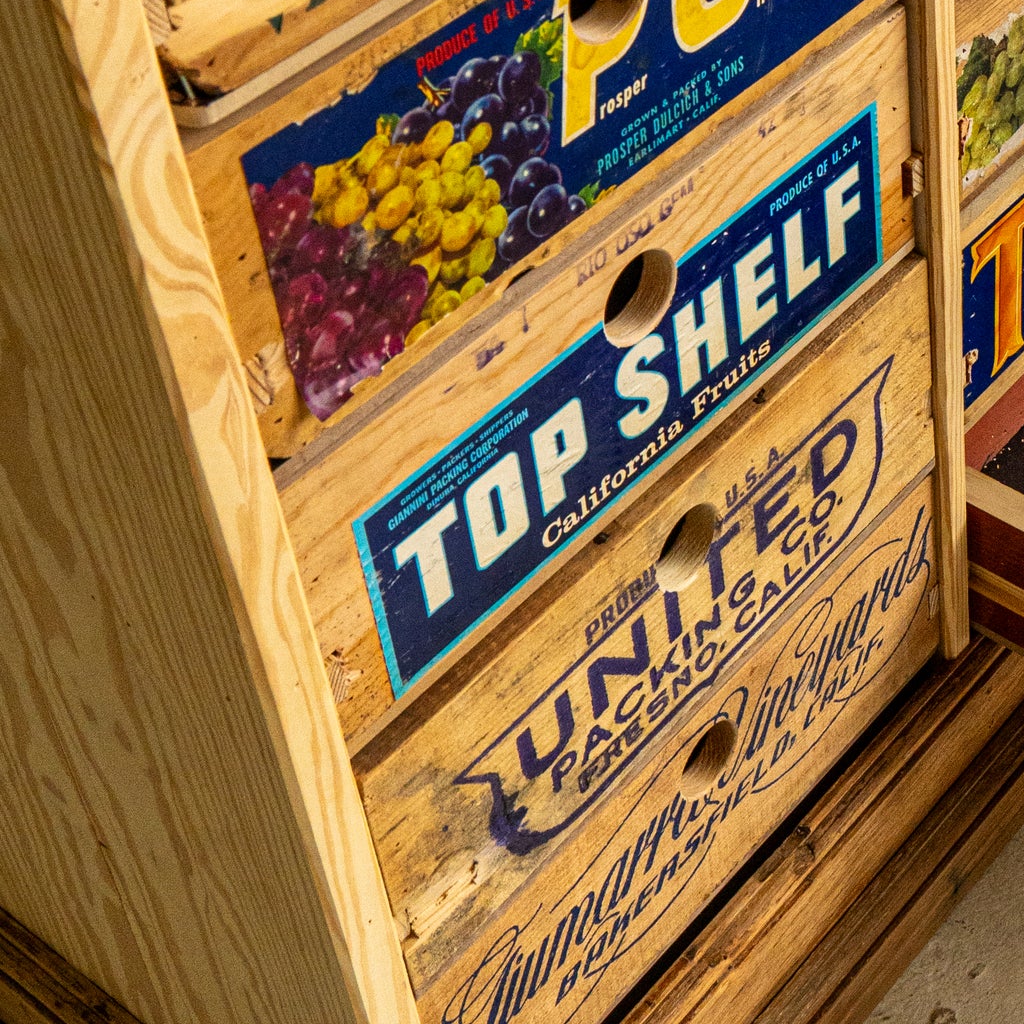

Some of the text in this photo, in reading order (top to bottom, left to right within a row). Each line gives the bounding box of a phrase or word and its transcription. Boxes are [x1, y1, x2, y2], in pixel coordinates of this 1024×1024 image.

[415, 22, 479, 77] PRODUCE
[482, 8, 500, 35] OF
[600, 73, 648, 120] rosper
[621, 59, 723, 137] GROWN & PACKED BY
[597, 55, 745, 176] PROSPER DULCICH & SONS
[628, 95, 722, 168] EARLIMART CALIF.
[769, 139, 862, 217] PRODUCE OF U.S.A.
[394, 161, 862, 619] TOP SHELF
[541, 338, 772, 550] California Fruits
[387, 407, 530, 532] GIANNINI PACKING CORPORATION
[400, 409, 514, 507] GROWERS PACKERS SHIPPERS
[457, 447, 499, 486] CALIFORNIA
[516, 418, 857, 779] UNITED
[734, 523, 833, 629] CALIF.
[553, 490, 843, 794] PACKING CO.
[716, 506, 936, 788] Vineyards
[556, 733, 796, 1007] BAKERSFIELD,
